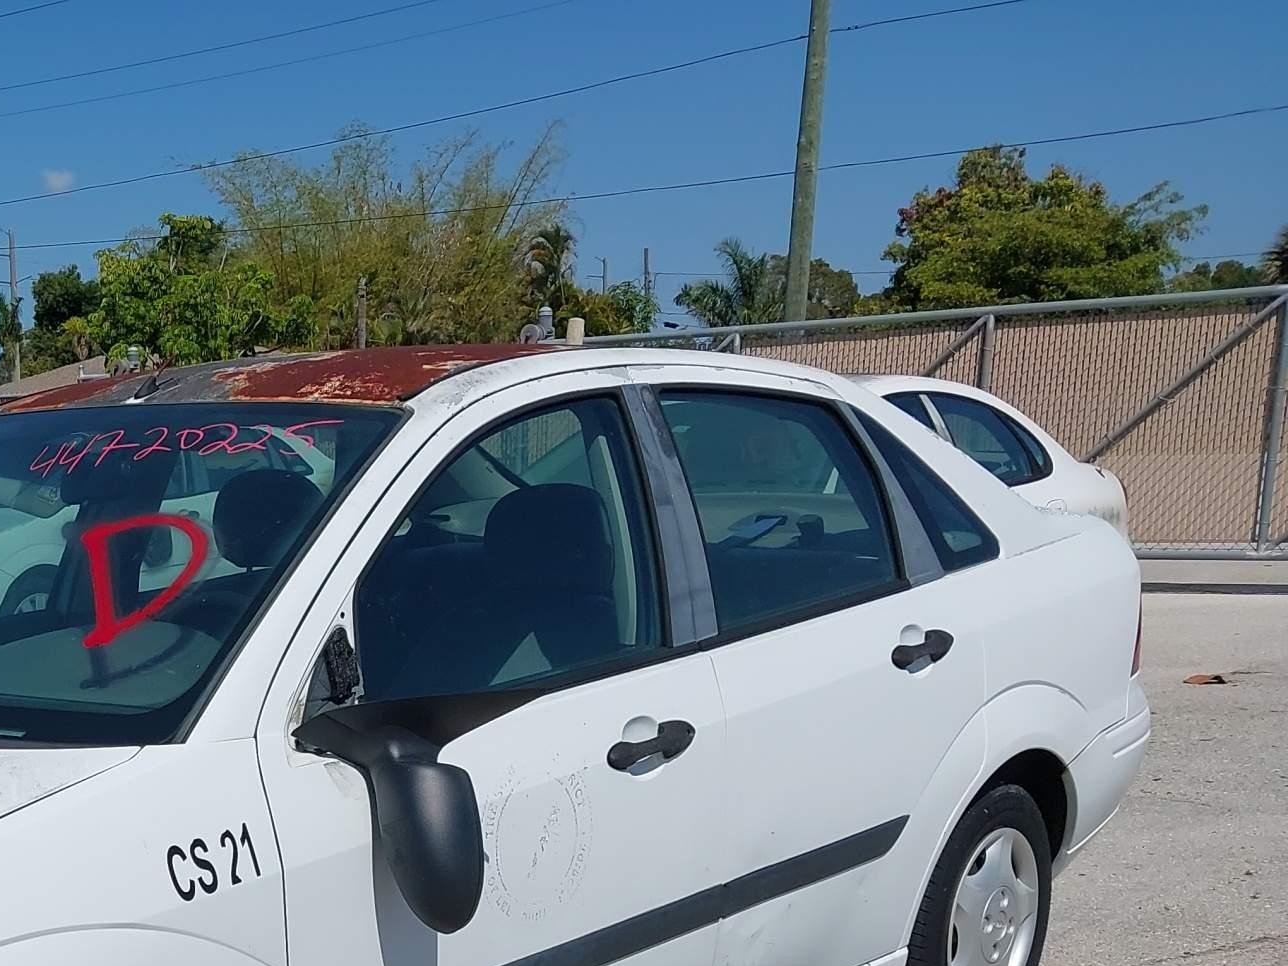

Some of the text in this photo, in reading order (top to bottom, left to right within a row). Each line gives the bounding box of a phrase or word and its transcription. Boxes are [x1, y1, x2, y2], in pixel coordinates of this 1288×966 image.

[80, 513, 209, 648] D
[166, 822, 261, 902] CS 21
